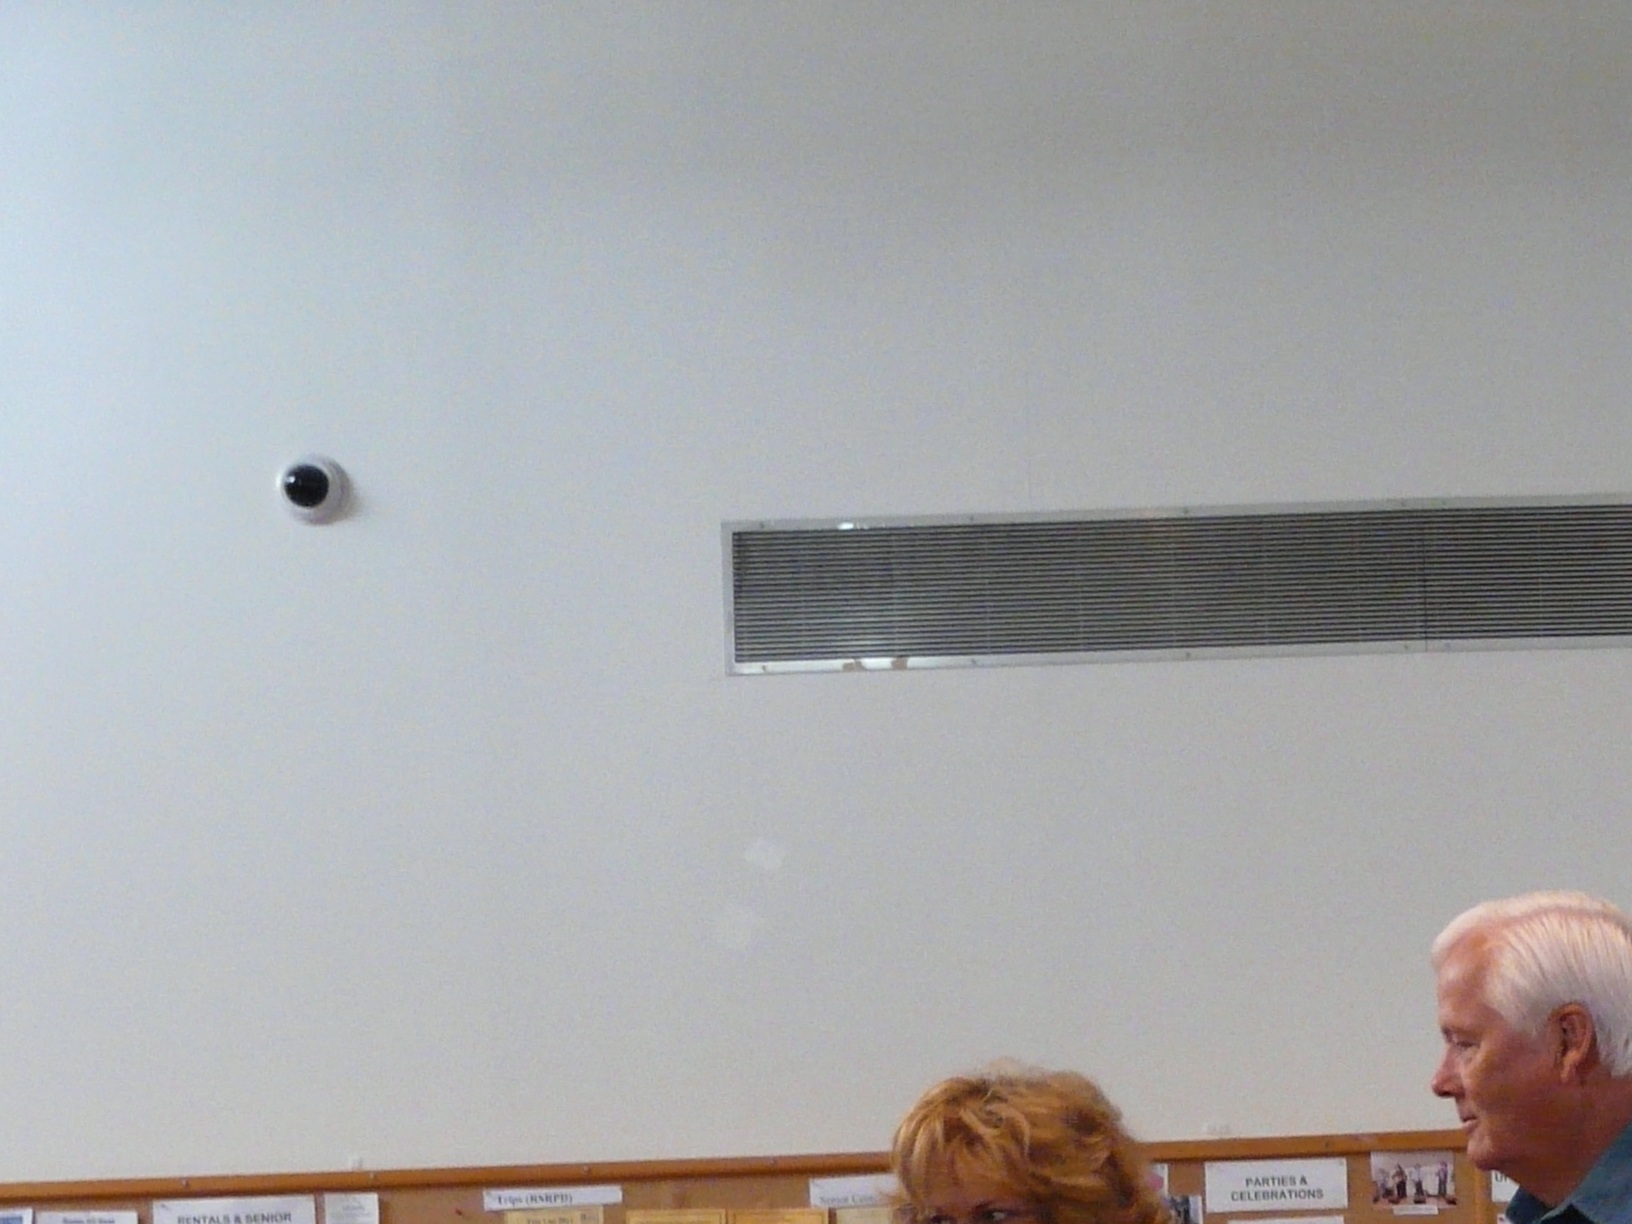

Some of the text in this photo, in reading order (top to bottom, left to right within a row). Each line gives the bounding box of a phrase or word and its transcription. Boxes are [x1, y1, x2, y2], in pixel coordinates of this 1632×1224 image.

[1245, 1176, 1298, 1188] PARTIES
[1231, 1188, 1325, 1202] CELEBRATIONS
[234, 1213, 243, 1224] &
[245, 1212, 293, 1224] SENIOR
